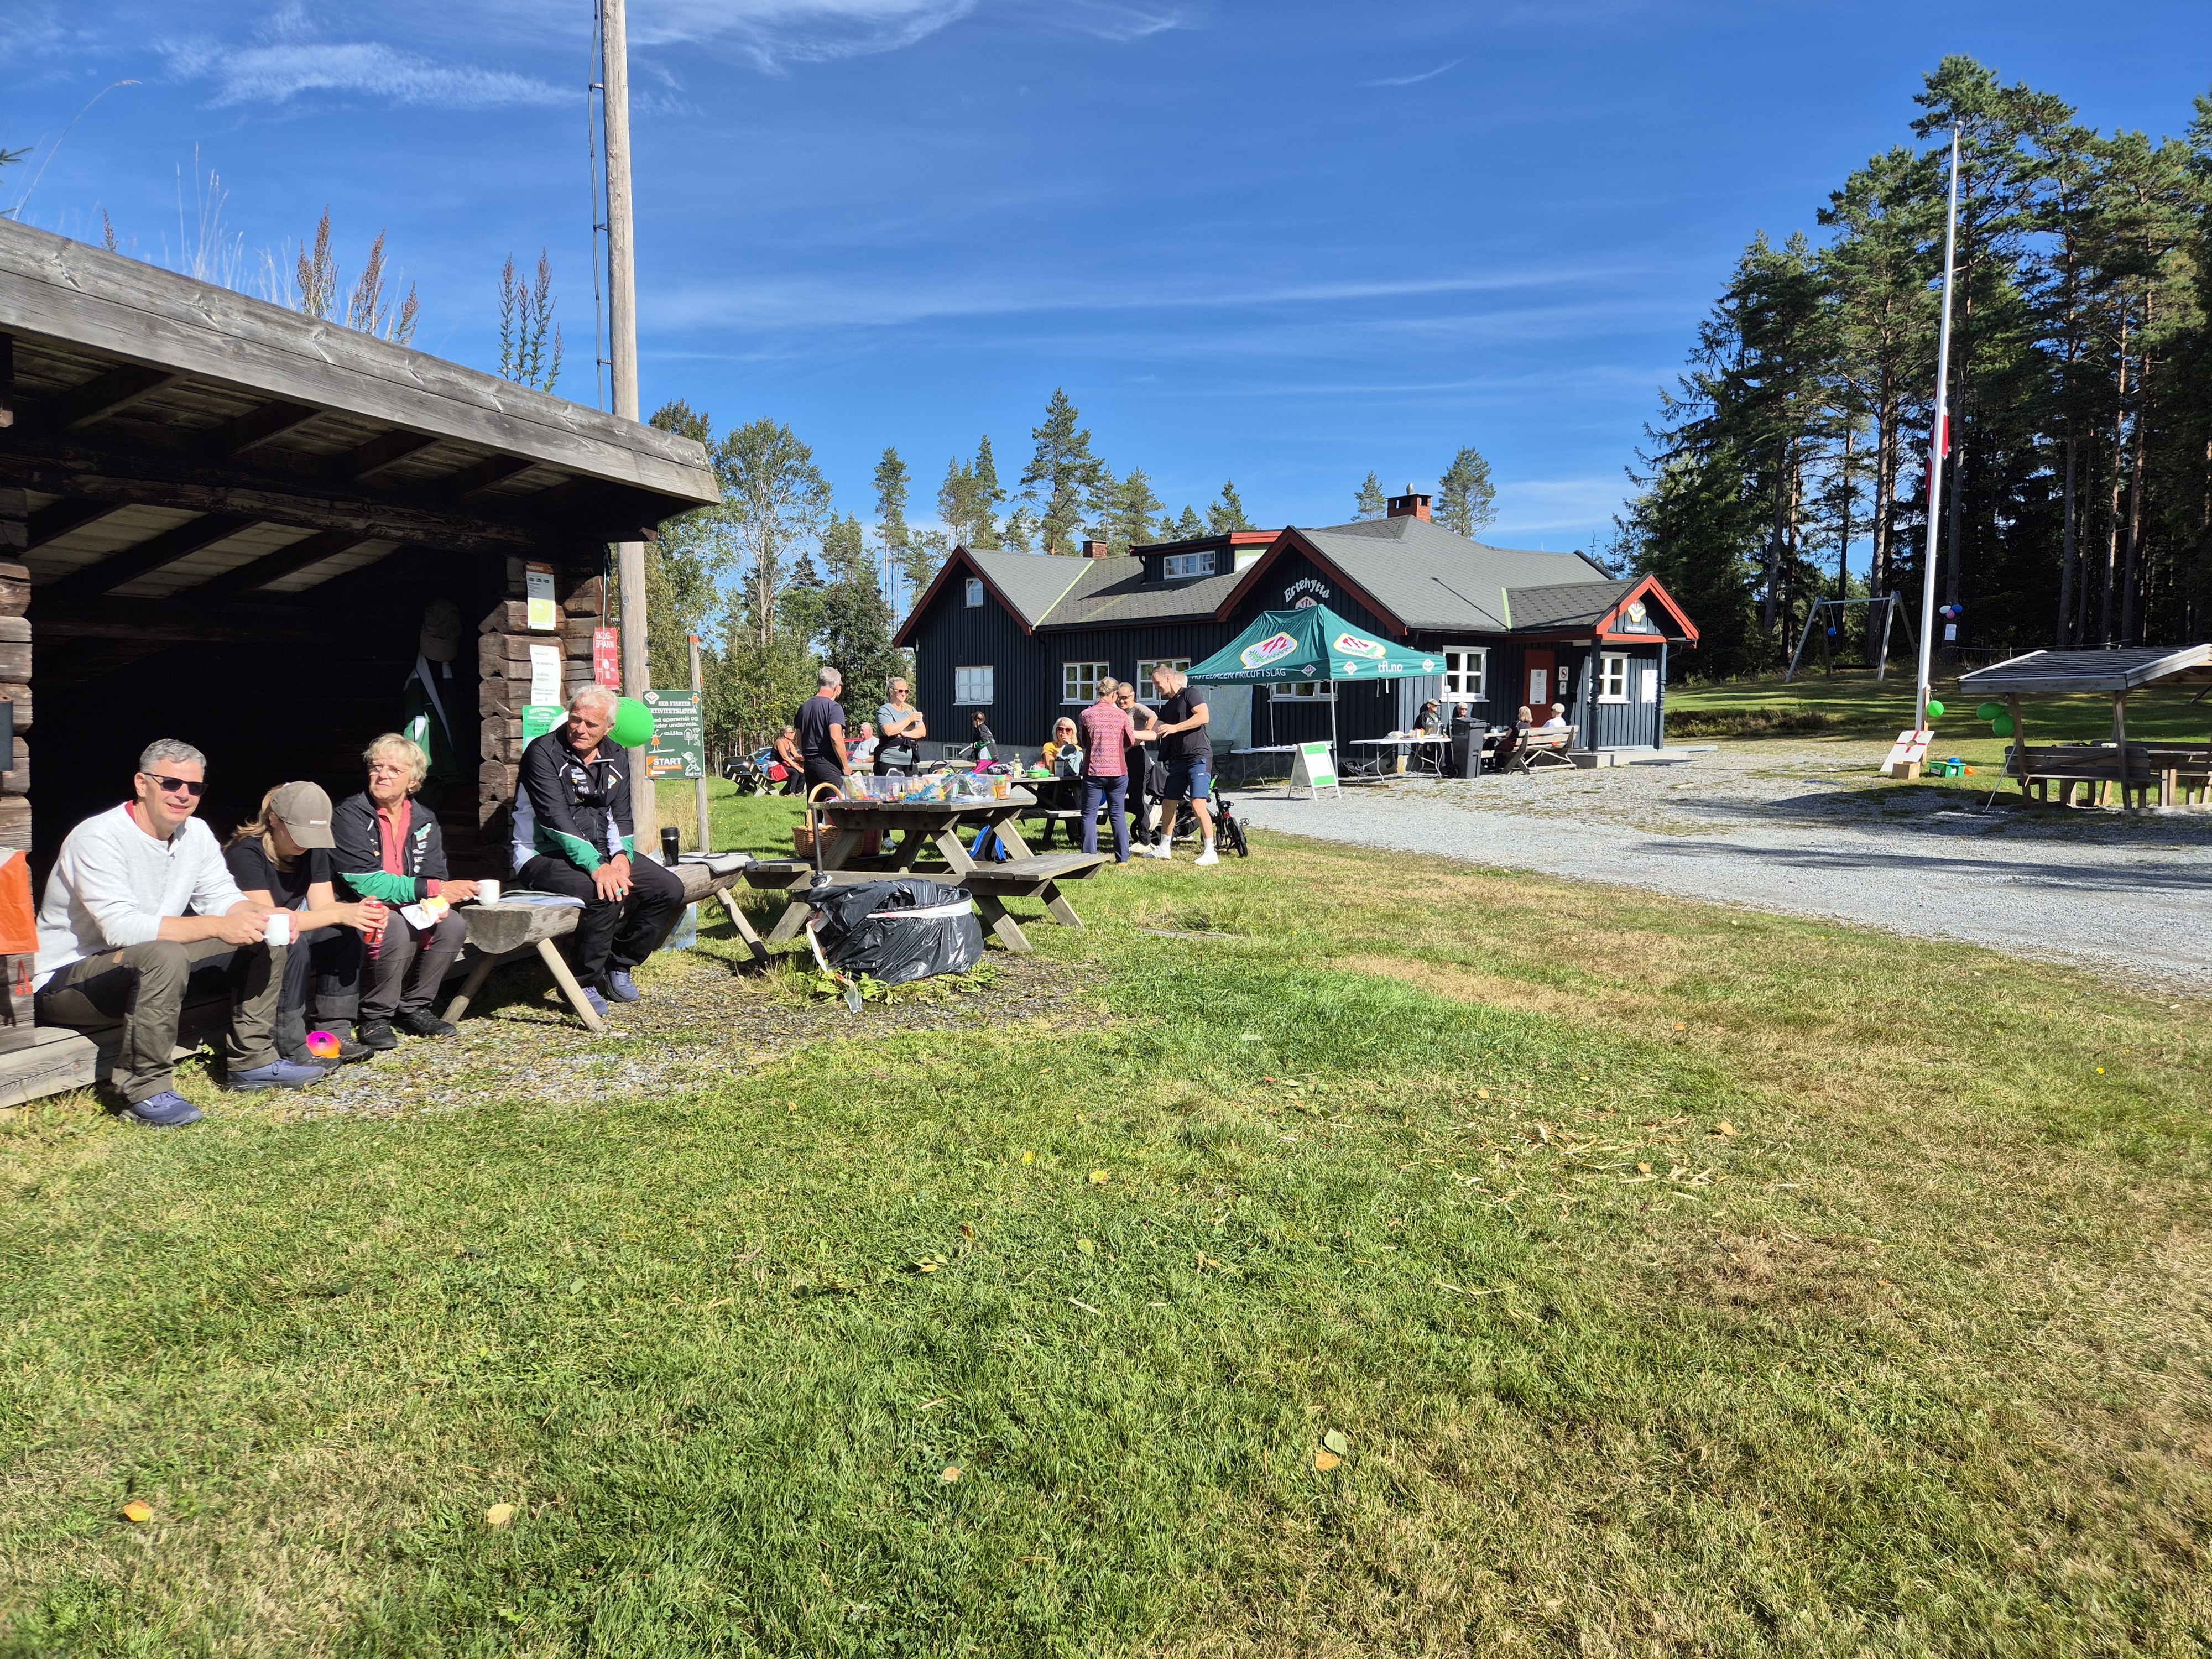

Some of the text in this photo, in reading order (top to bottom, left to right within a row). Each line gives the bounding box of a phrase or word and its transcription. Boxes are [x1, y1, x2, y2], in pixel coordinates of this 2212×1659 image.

[1284, 577, 1330, 603] Ertehytta
[1262, 636, 1288, 654] TFL
[1342, 636, 1368, 649] TFL
[1235, 668, 1286, 679] FRILUFTSLAG
[1378, 660, 1403, 674] tfl.no
